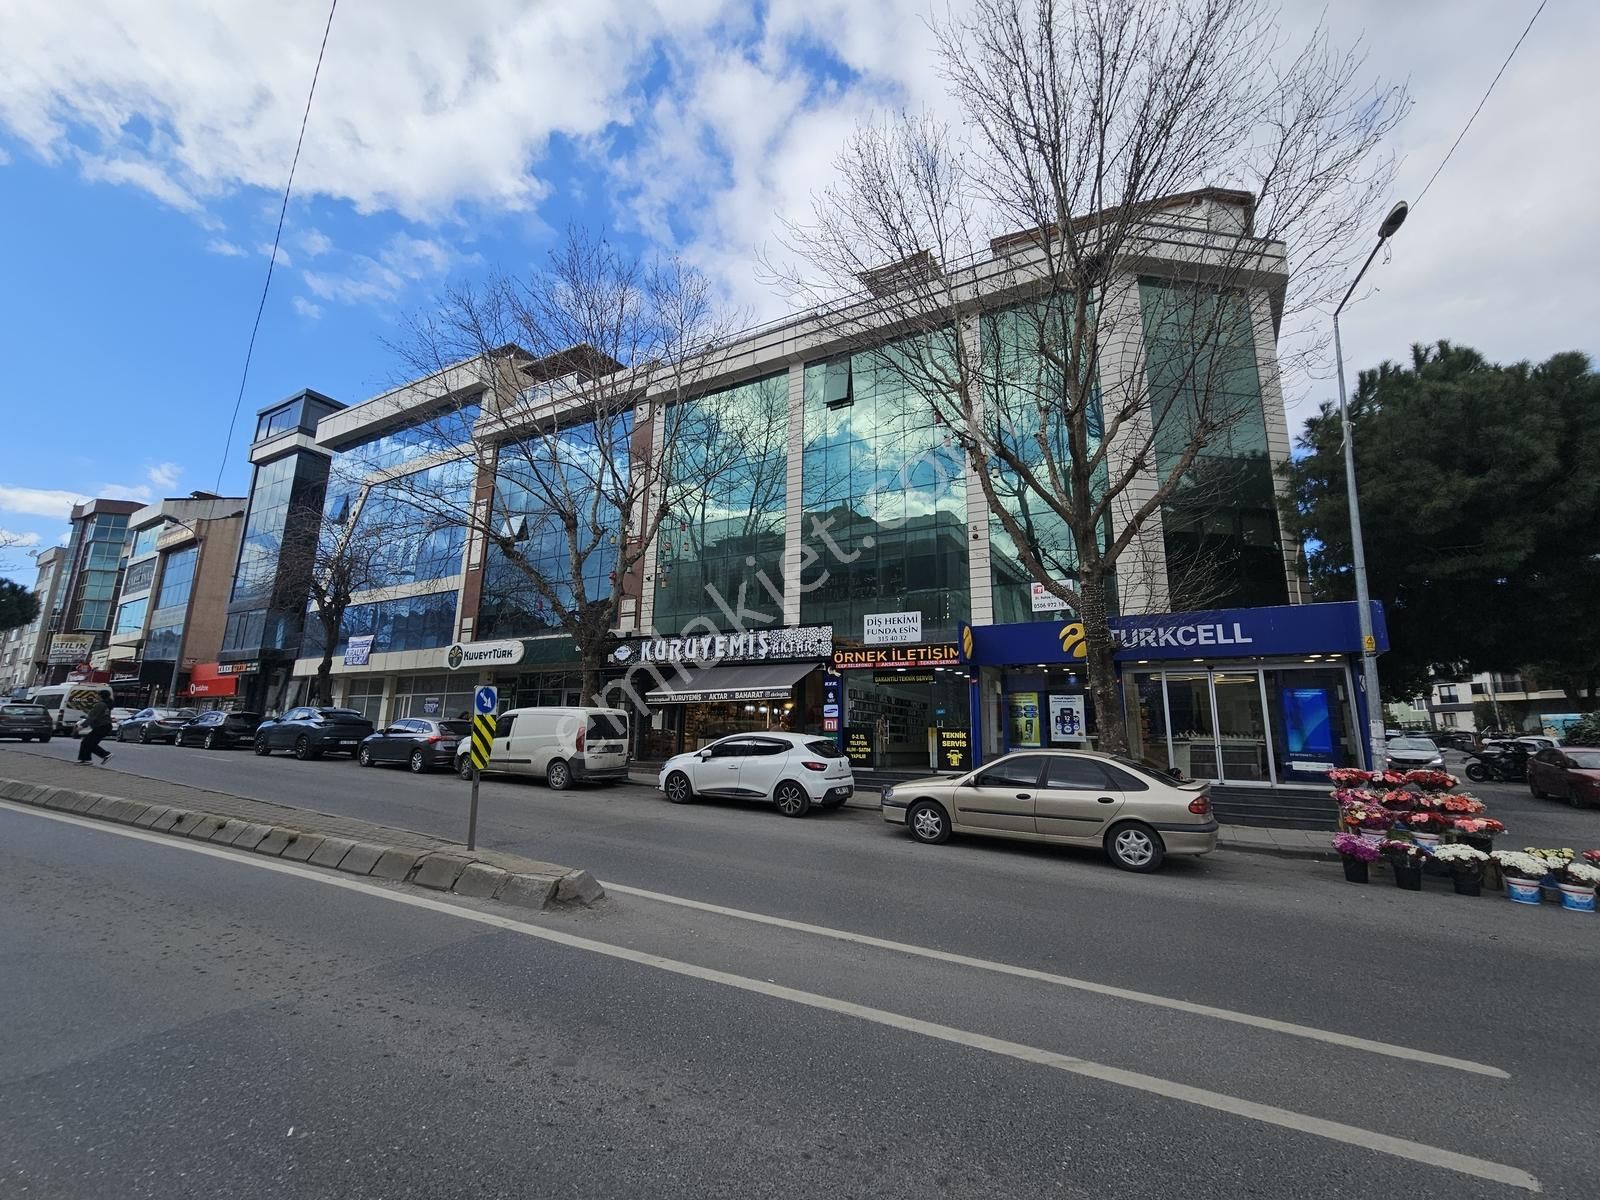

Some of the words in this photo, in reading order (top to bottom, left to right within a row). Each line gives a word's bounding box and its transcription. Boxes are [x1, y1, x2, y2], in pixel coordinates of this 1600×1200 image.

[866, 618, 882, 627] DİŞ
[884, 614, 918, 624] HEKİMİ
[866, 627, 897, 636] FUNDA
[899, 625, 918, 633] ESİN
[1110, 622, 1253, 649] TURKCELL
[641, 629, 769, 662] KURUYEMİŞ
[771, 640, 816, 655] AKTAR
[834, 650, 887, 664] ÖRNEK
[708, 692, 728, 700] AKTAR
[735, 691, 764, 699] BAHARAT
[941, 730, 967, 739] TEKNİK
[941, 739, 967, 748] SERVİS
